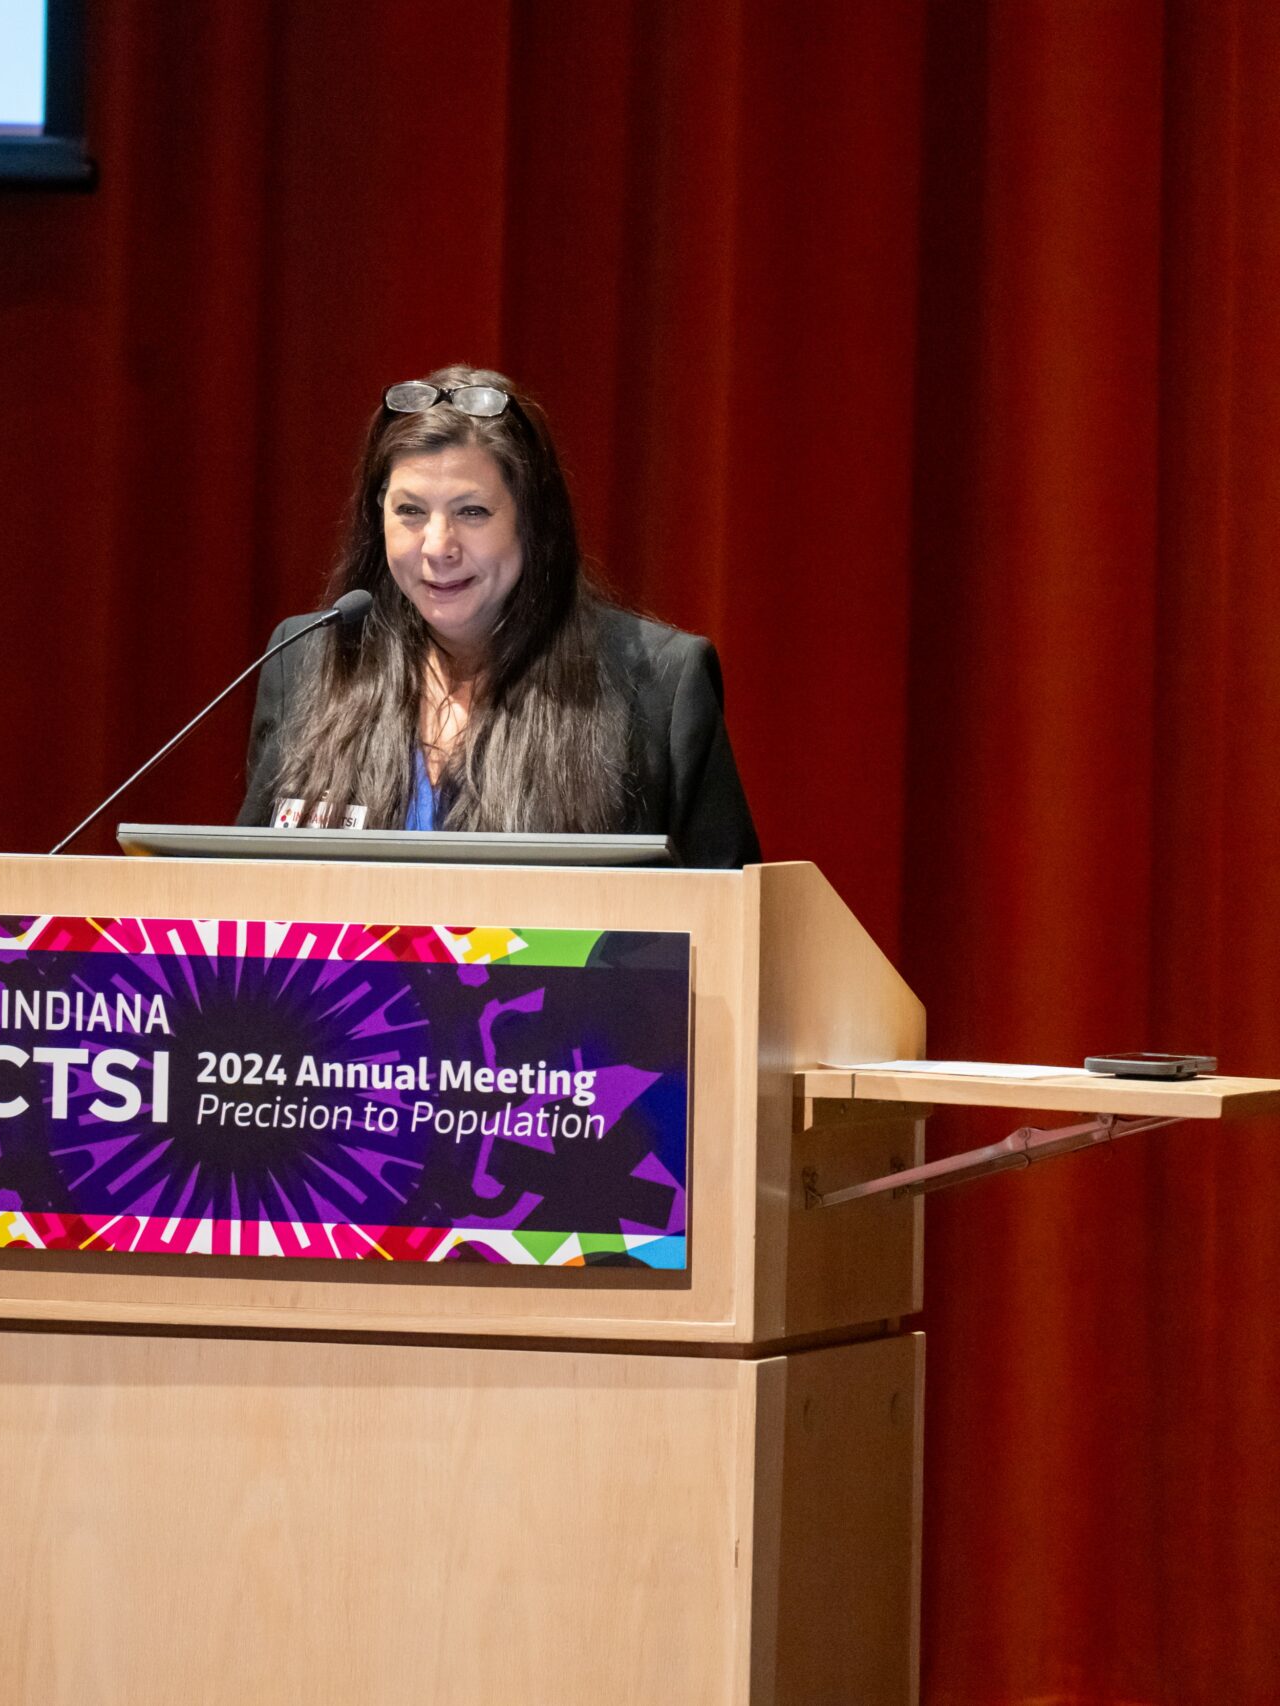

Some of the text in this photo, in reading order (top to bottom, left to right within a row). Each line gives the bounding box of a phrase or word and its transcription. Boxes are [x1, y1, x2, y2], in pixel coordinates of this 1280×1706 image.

[1, 989, 170, 1034] INDIANA
[197, 1051, 597, 1107] 2024 Annual Meeting
[197, 1094, 605, 1144] Precision to Population
